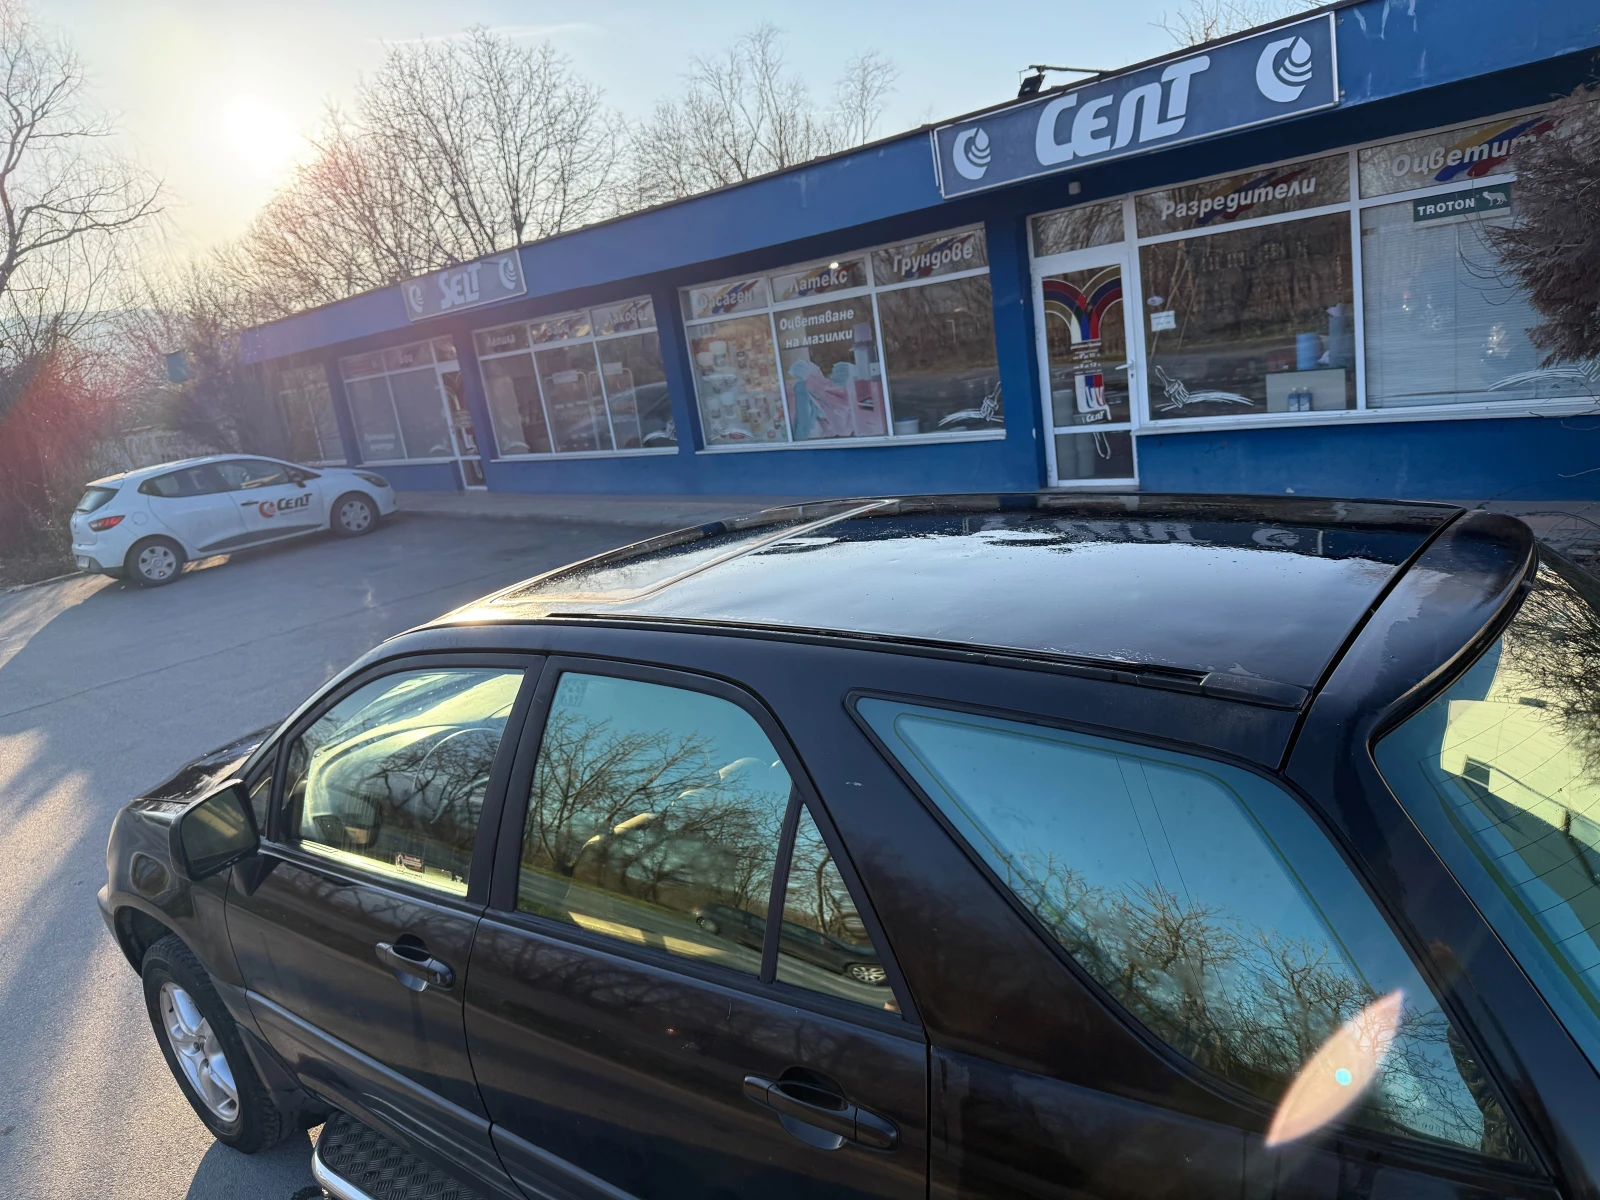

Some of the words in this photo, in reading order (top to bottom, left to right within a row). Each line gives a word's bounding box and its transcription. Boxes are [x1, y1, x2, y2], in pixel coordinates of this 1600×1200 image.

[1161, 173, 1317, 221] Разредители
[1417, 197, 1476, 216] TROTON
[893, 242, 973, 276] Грундове
[438, 261, 482, 310] SELT
[789, 267, 848, 293] Латекс
[779, 309, 854, 331] Оцветяване
[786, 336, 799, 348] на
[802, 328, 853, 347] мазилки
